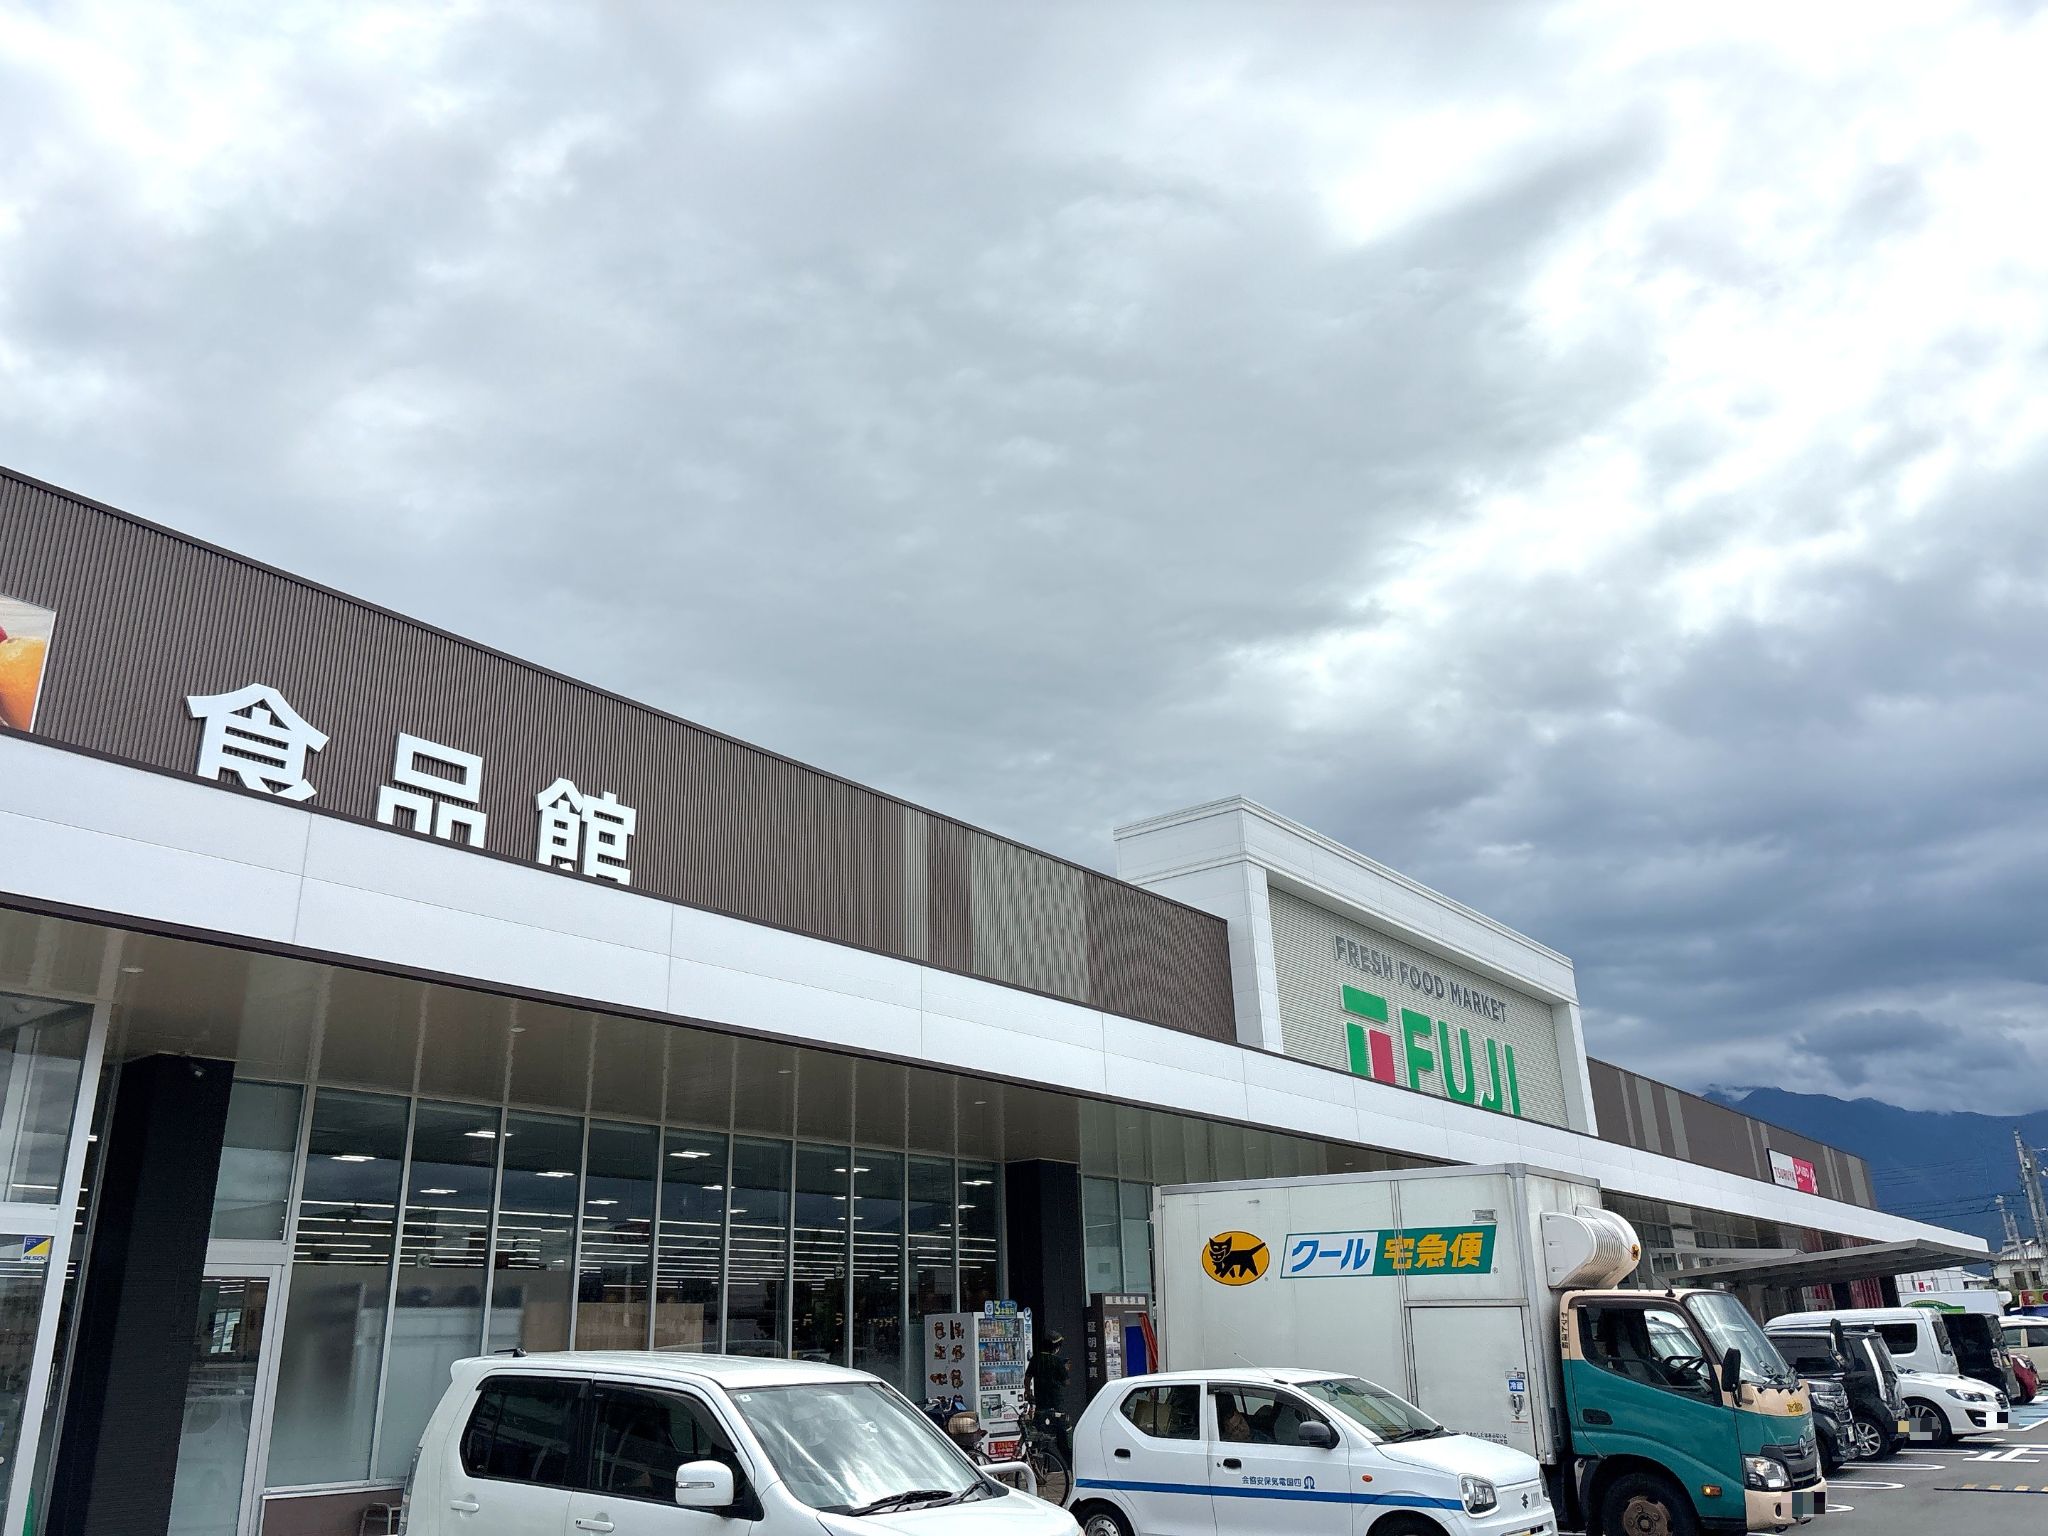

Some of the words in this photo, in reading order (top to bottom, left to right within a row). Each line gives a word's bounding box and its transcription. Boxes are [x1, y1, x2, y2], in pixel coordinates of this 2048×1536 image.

[186, 683, 636, 884] 食品館
[1333, 935, 1392, 980] FRESH
[1399, 961, 1445, 998] FOOD
[1450, 981, 1507, 1023] MARKET
[1400, 1007, 1522, 1117] FUJI
[1291, 1238, 1371, 1273] クール
[1384, 1231, 1484, 1269] 宅急便
